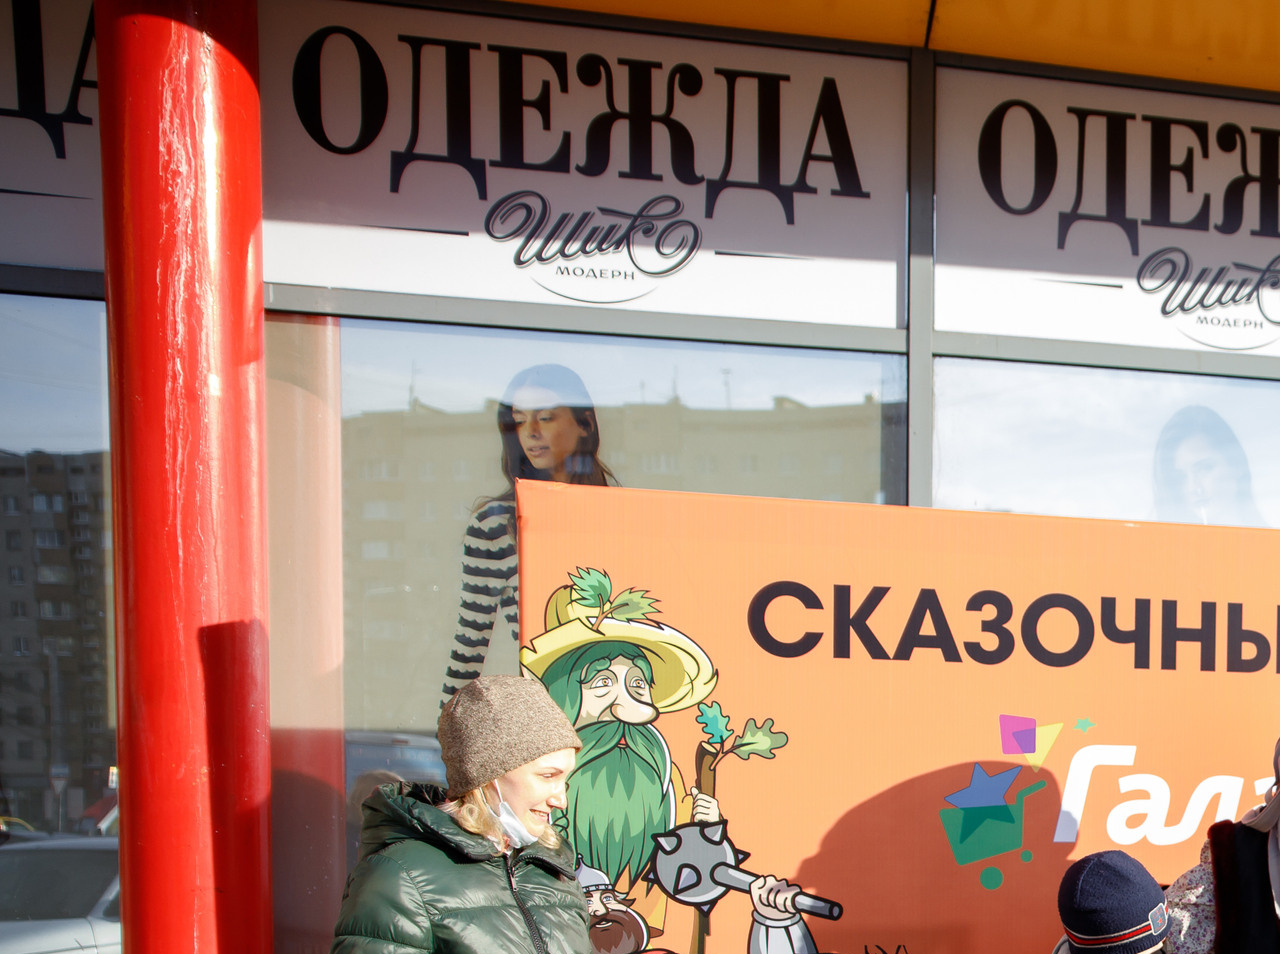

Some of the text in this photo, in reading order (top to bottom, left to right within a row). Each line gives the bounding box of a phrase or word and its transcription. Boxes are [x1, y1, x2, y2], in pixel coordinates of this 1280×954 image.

[292, 25, 871, 226] ОДЕЖДА
[554, 264, 637, 282] МОДЕРН
[1196, 314, 1265, 330] МОДЕРН
